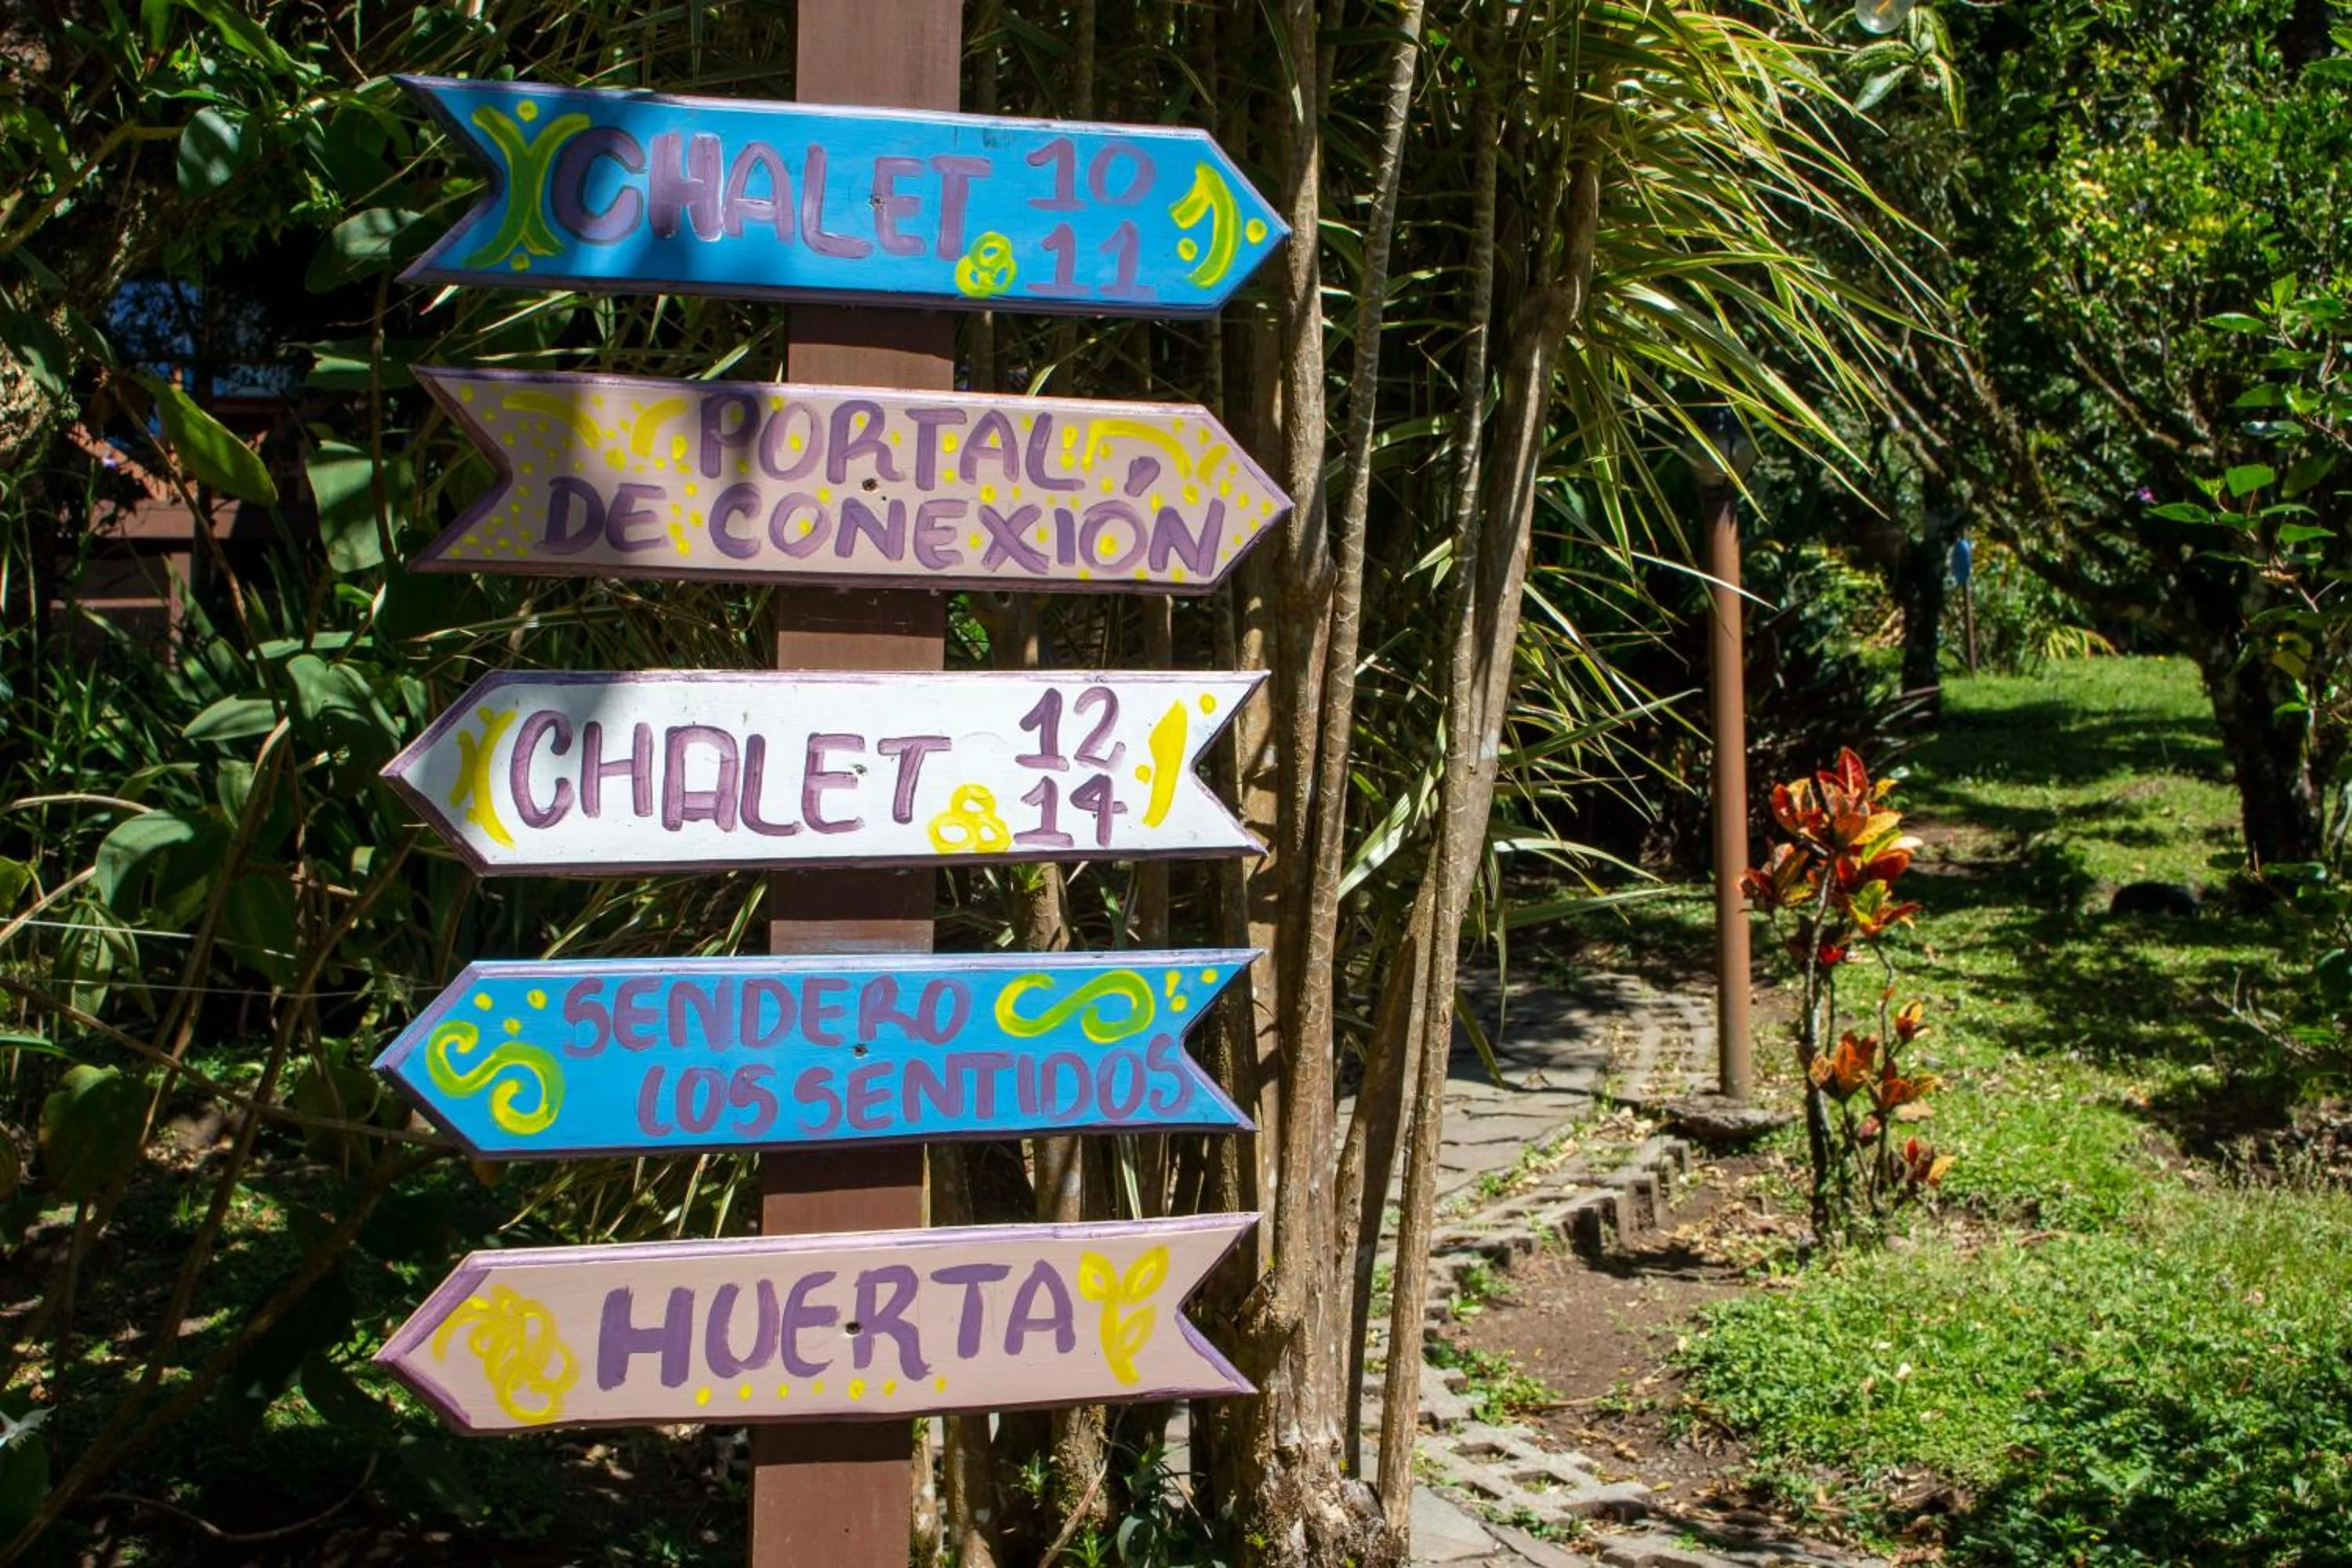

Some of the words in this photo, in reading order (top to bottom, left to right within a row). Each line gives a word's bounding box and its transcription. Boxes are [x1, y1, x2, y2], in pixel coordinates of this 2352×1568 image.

[550, 125, 990, 262] CHALET
[1027, 136, 1156, 211] 10
[1025, 221, 1156, 298] 11
[699, 394, 1086, 492] PORTAL
[533, 477, 673, 556] DE
[510, 709, 952, 836] CHALET
[1015, 687, 1126, 771] 12
[1014, 774, 1126, 848] 14
[563, 976, 972, 1058] SENDERO
[637, 1063, 779, 1136] LOS
[793, 1034, 1195, 1137] SENTIDOS
[597, 1260, 1075, 1392] HUERTA
